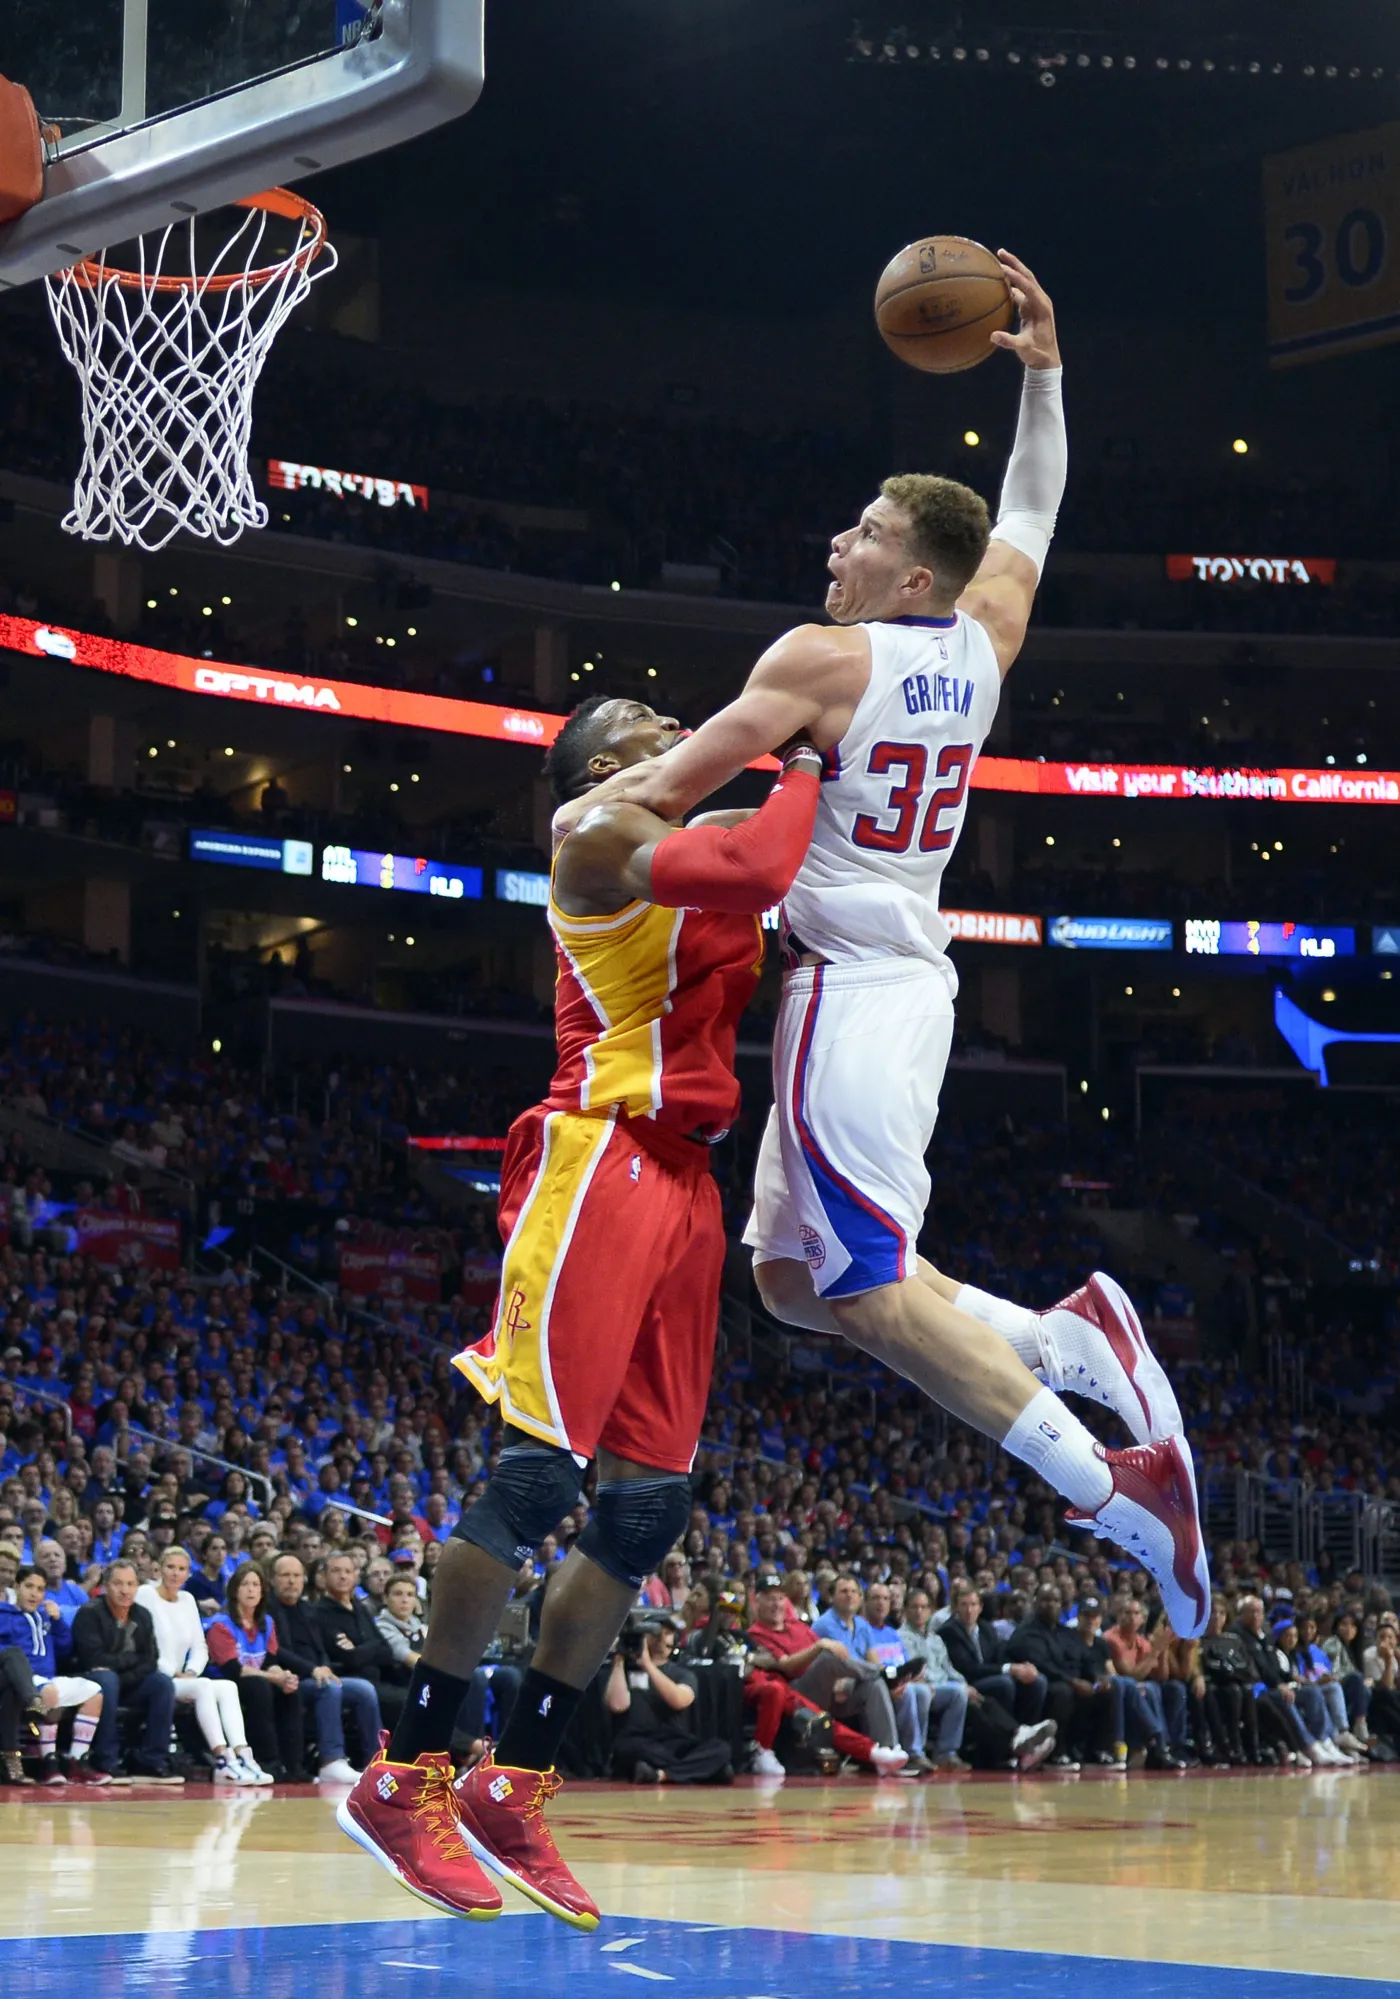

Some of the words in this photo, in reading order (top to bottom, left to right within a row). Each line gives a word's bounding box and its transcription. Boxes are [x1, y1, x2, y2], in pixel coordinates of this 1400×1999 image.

[1284, 206, 1386, 304] 30
[195, 668, 341, 710] OPTIMA
[851, 741, 974, 854] 32
[1065, 766, 1119, 792] Visit
[1123, 773, 1177, 797] your
[1291, 774, 1399, 800] California
[941, 911, 1040, 943] OSHIBA
